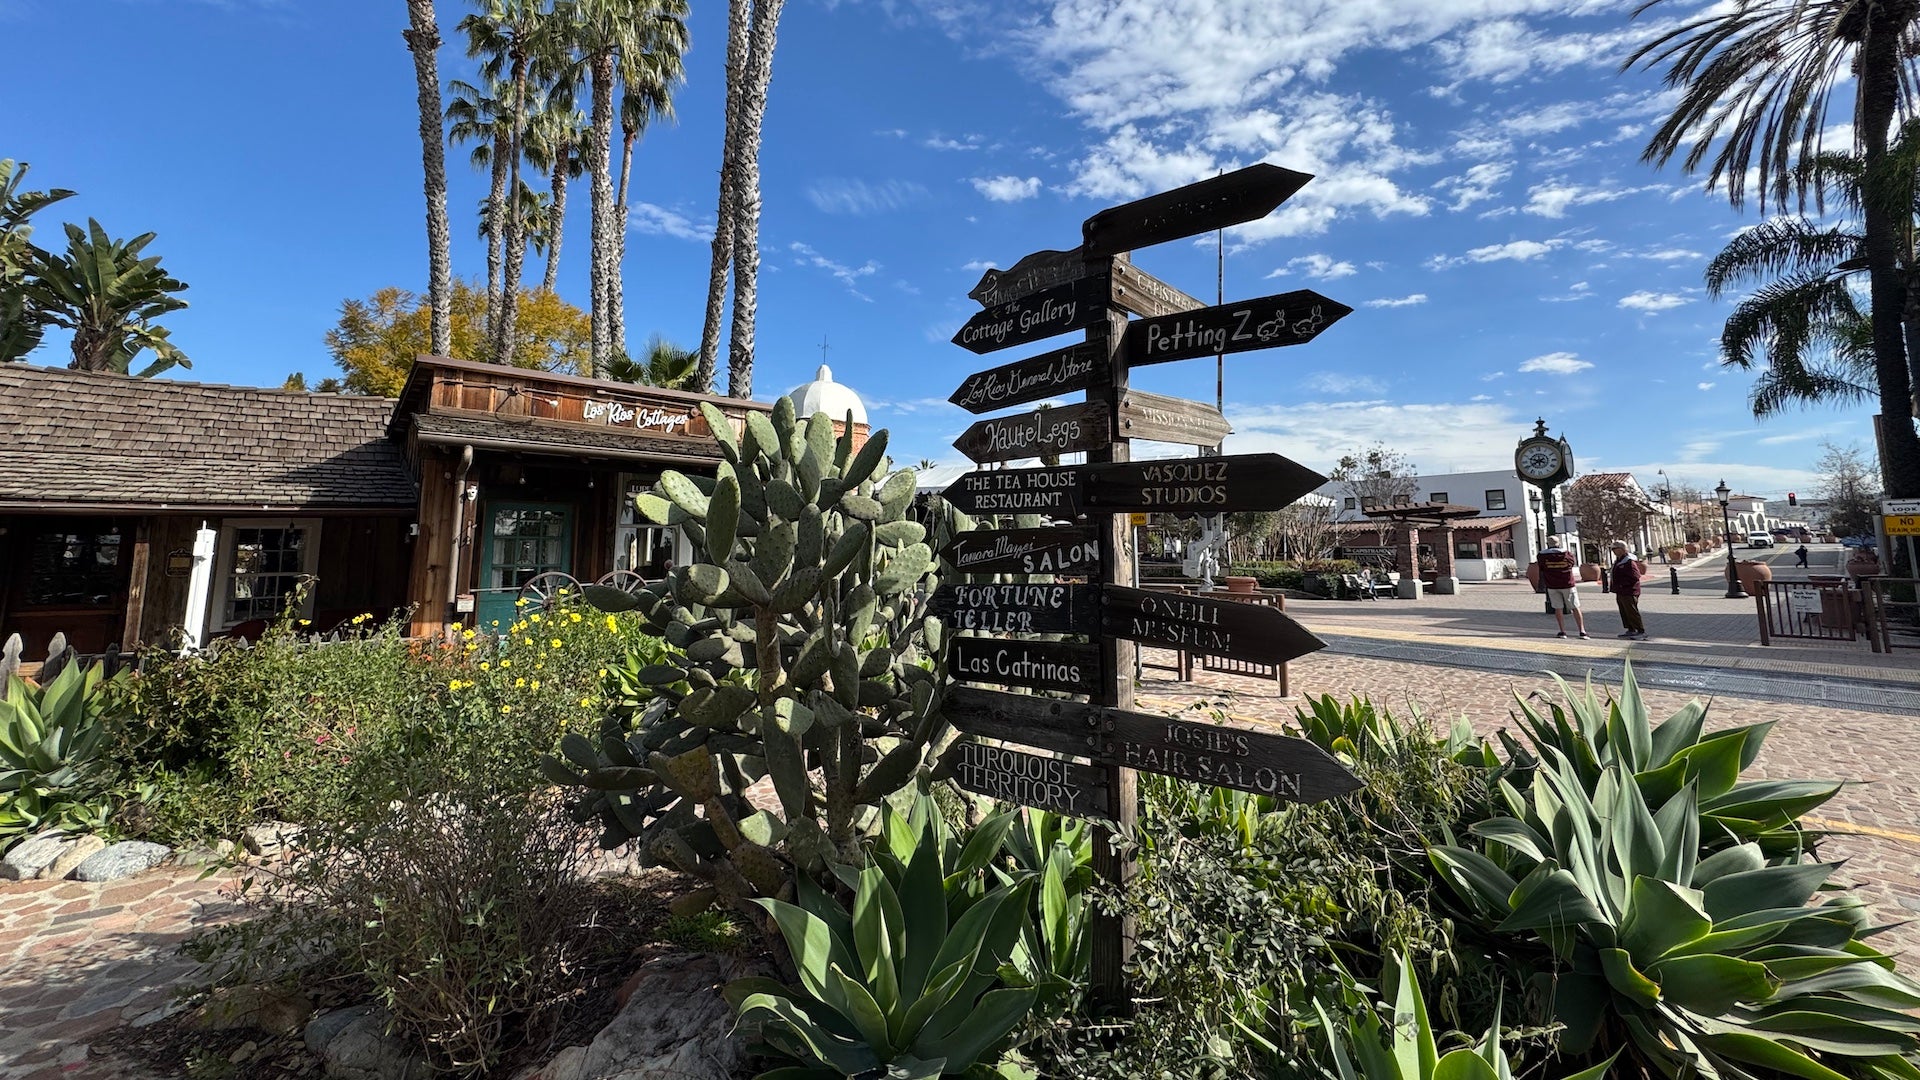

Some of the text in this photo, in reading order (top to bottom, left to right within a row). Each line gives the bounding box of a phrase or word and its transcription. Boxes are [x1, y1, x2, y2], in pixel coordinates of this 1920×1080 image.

[962, 297, 1077, 344] Cottage Gallery
[1005, 300, 1021, 315] The
[1147, 319, 1226, 354] Petting
[1006, 363, 1051, 397] General
[1051, 354, 1093, 386] Store
[583, 400, 690, 433] Los Rios Cottages
[965, 471, 1077, 491] THE TEA HOUSE
[1141, 462, 1229, 482] VASQUEZ
[975, 491, 1063, 509] RESTAURANT
[1141, 485, 1227, 505] STUDIOS
[1900, 517, 1915, 526] NO
[1023, 540, 1100, 573] SALON
[955, 585, 1065, 609] FORTUNE
[953, 609, 1034, 633] TELLER
[1132, 618, 1232, 652] MUSEUM
[957, 646, 1081, 683] Las Catrinas
[1163, 723, 1251, 757] JOSIE'S
[957, 740, 1078, 788] TURQUOISE
[1123, 740, 1303, 799] HAIR SALON
[956, 762, 1082, 811] TERRITORY
